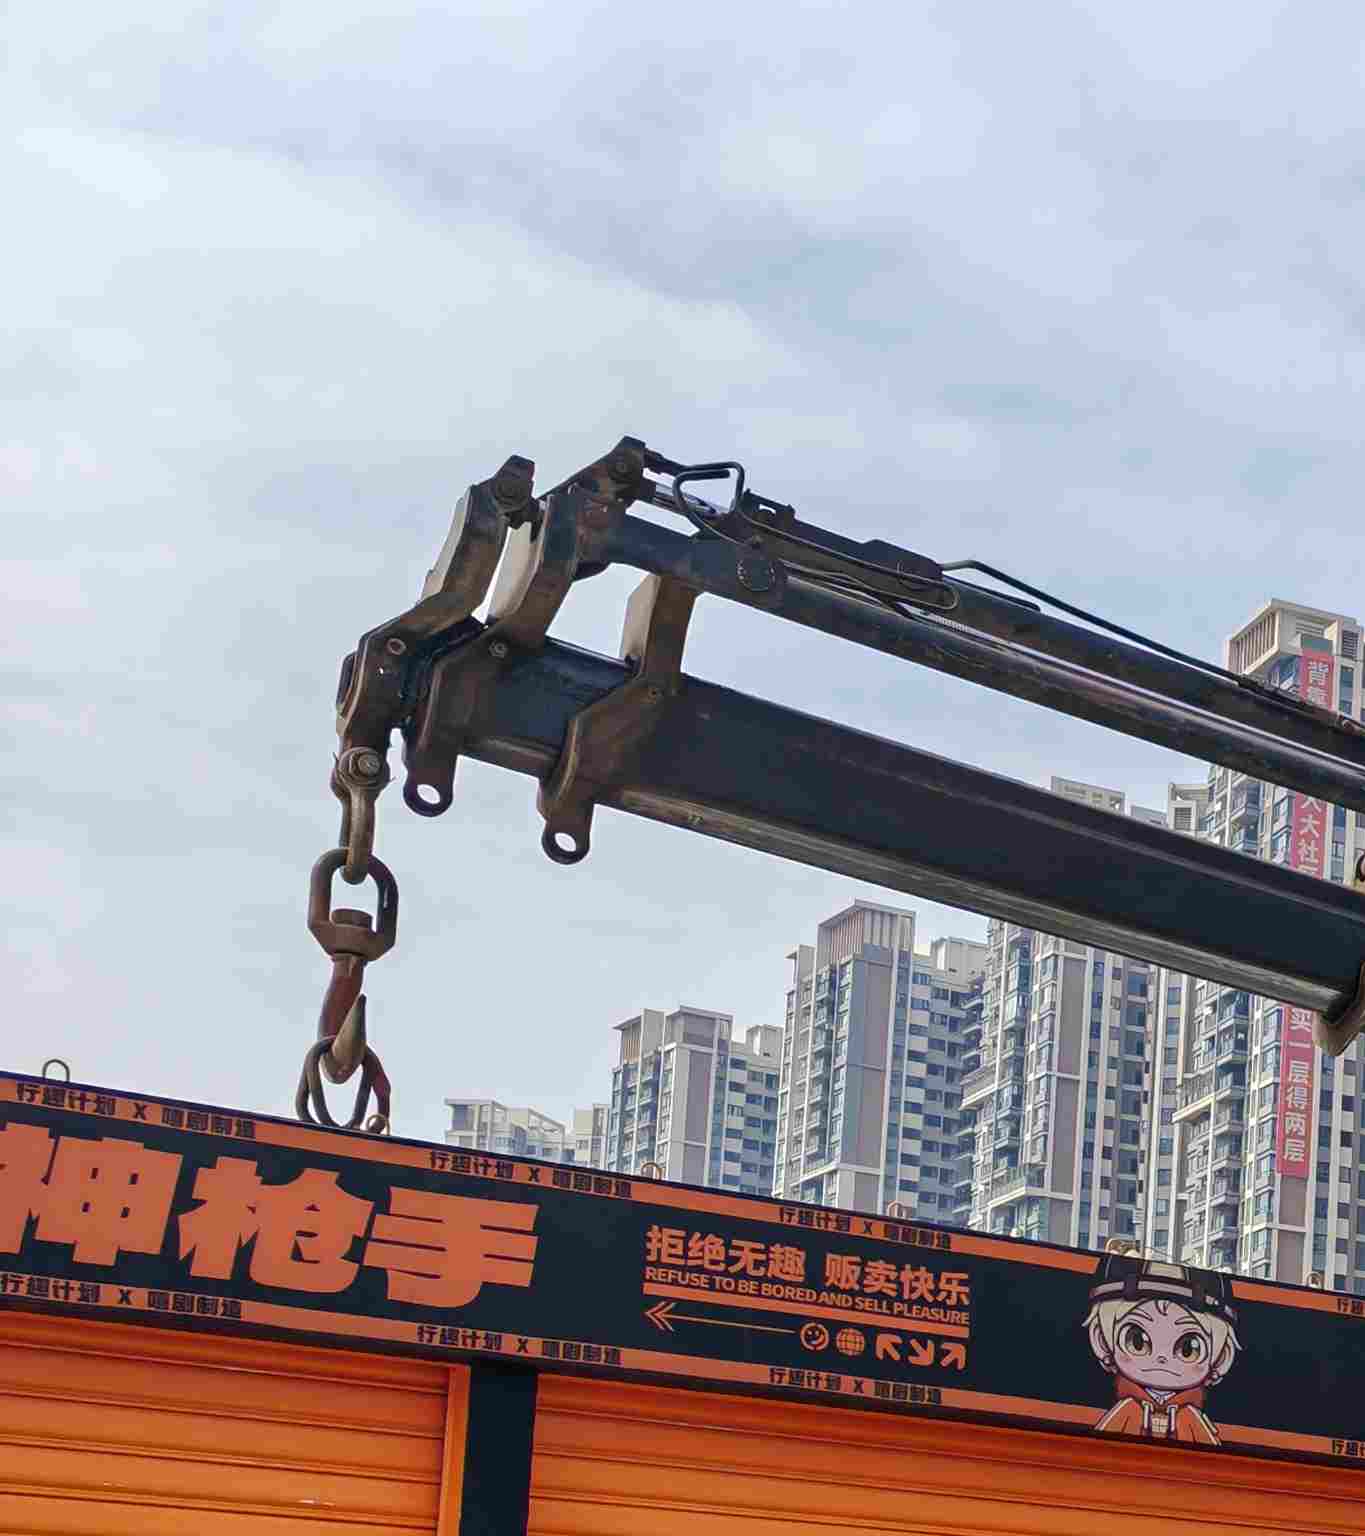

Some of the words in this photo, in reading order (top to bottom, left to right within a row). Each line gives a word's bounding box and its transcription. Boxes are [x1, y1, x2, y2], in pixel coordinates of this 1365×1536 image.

[645, 1224, 807, 1282] 拒绝无趣
[825, 1253, 971, 1307] 贩卖快乐
[645, 1267, 710, 1290] REFUSE
[712, 1275, 735, 1292] TO
[737, 1279, 759, 1295] BE
[760, 1281, 817, 1304] BORED
[817, 1290, 853, 1309] AND
[855, 1296, 892, 1314] SELL
[893, 1301, 971, 1326] PLEASURE
